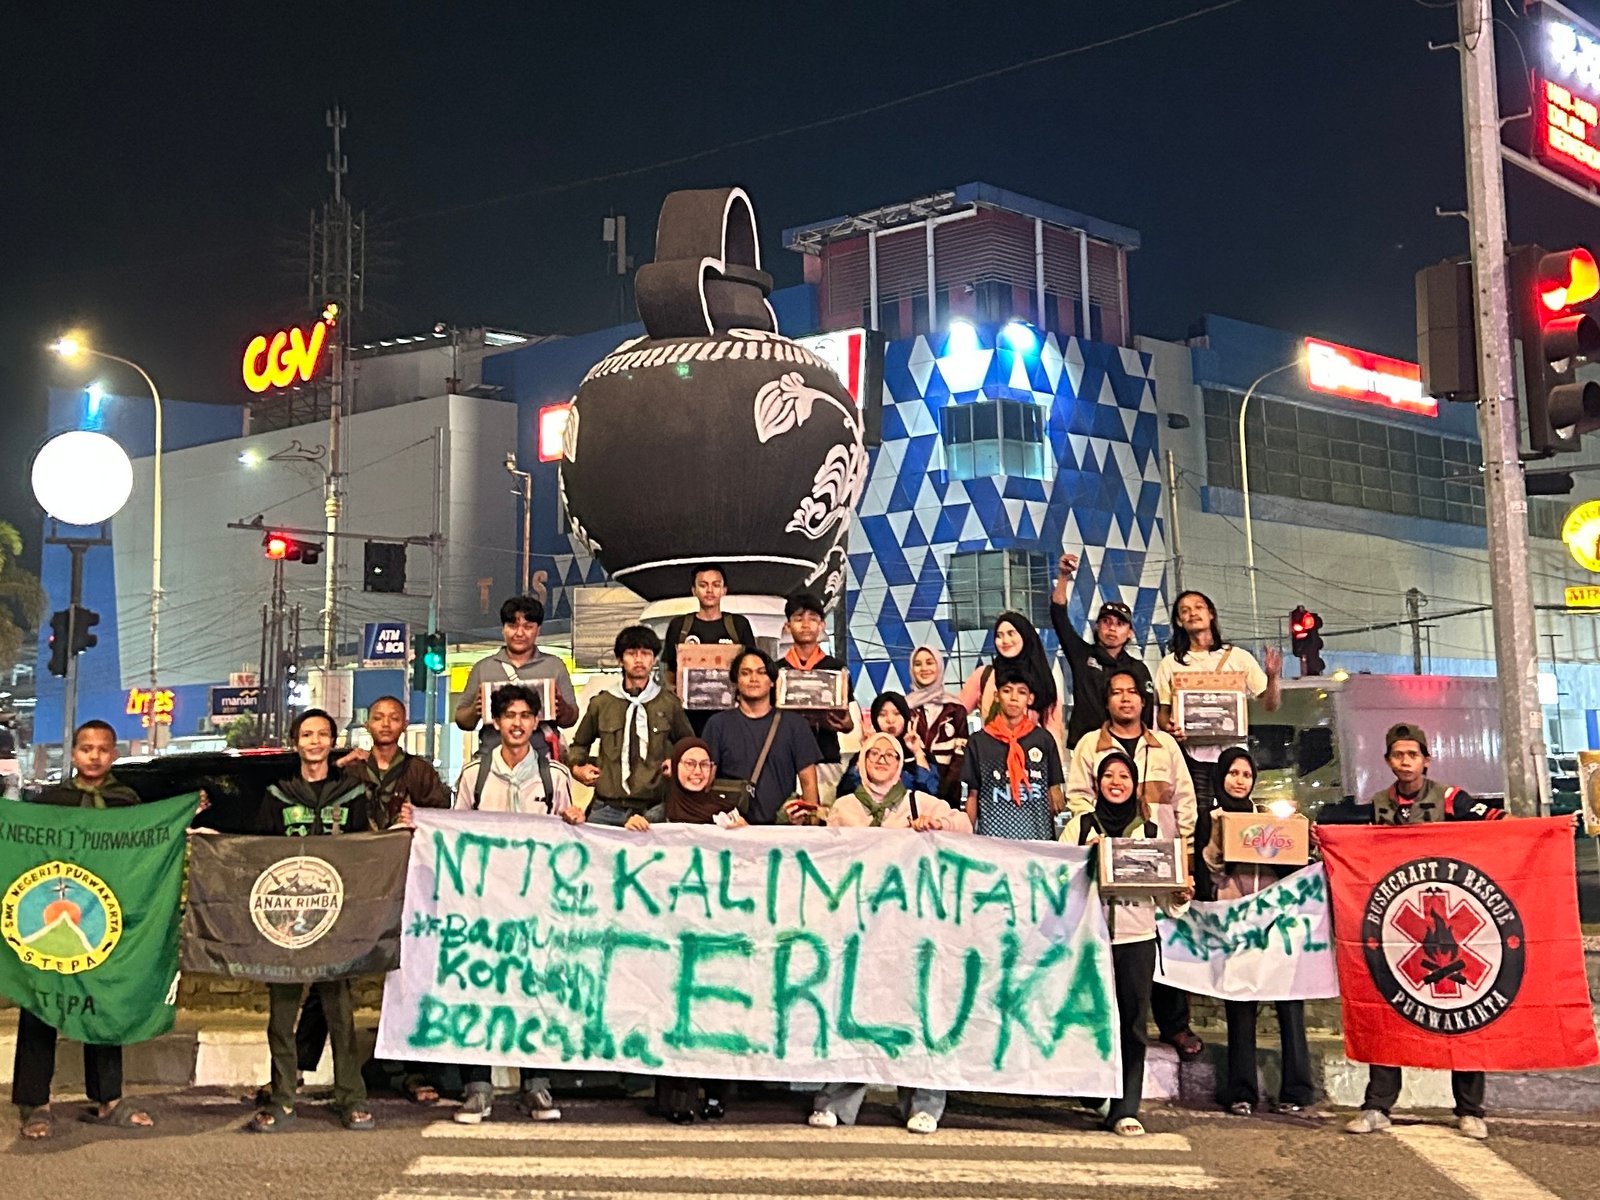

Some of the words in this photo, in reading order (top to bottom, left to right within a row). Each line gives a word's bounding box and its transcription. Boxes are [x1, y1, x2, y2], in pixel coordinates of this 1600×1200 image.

[243, 321, 327, 392] CGV
[379, 629, 400, 641] ATM
[7, 824, 63, 849] NEGERI
[82, 826, 170, 850] PURWAKARTA
[1242, 824, 1294, 848] LeVios
[4, 903, 15, 929] SMK
[11, 866, 52, 897] NEGERI
[65, 866, 119, 934] PURWAKARTA
[254, 896, 292, 910] ANAK
[296, 894, 338, 909] RIMBA
[614, 848, 1070, 932] KALIMANTAN
[1367, 861, 1438, 925] BUSHCRAFT
[1462, 869, 1516, 925] RESCUE
[23, 951, 97, 972] STEPA
[553, 929, 1112, 1073] TERLUKA
[1391, 989, 1508, 1031] PURWAKARTA
